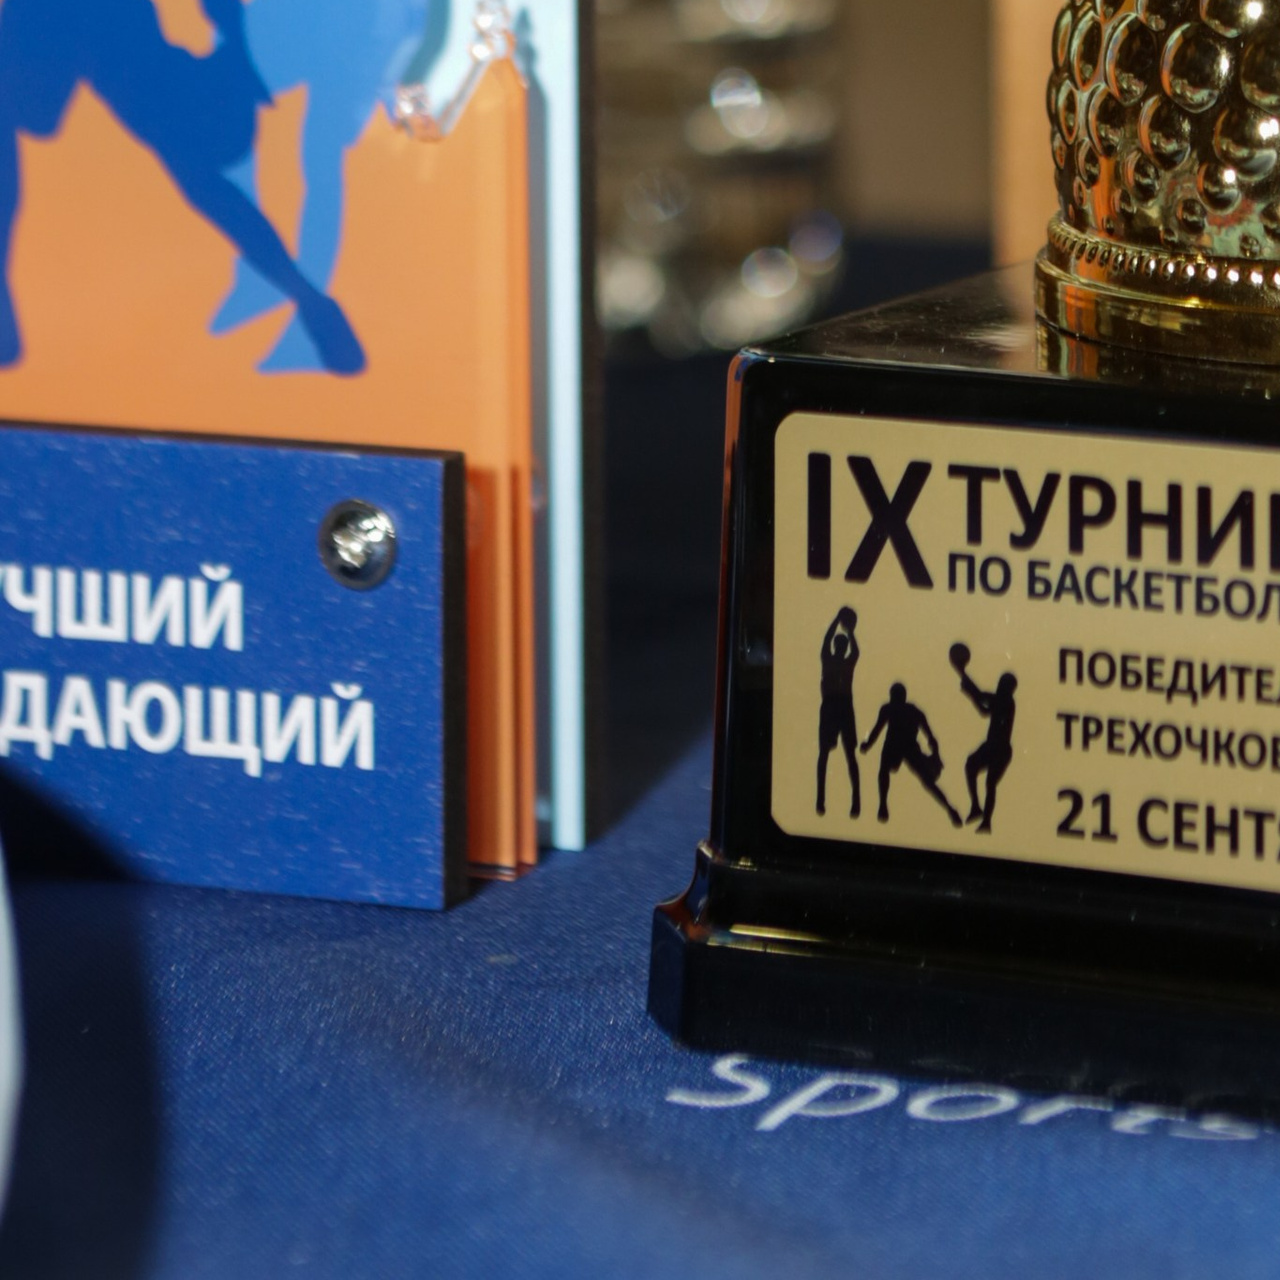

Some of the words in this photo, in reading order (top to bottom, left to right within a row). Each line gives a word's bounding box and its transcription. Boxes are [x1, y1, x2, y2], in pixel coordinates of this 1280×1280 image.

[805, 450, 935, 590] IX
[0, 561, 245, 652] ЧШИЙ
[947, 555, 1012, 597] ПО
[0, 668, 376, 778] ДАЮЩИЙ
[1056, 788, 1119, 842] 21
